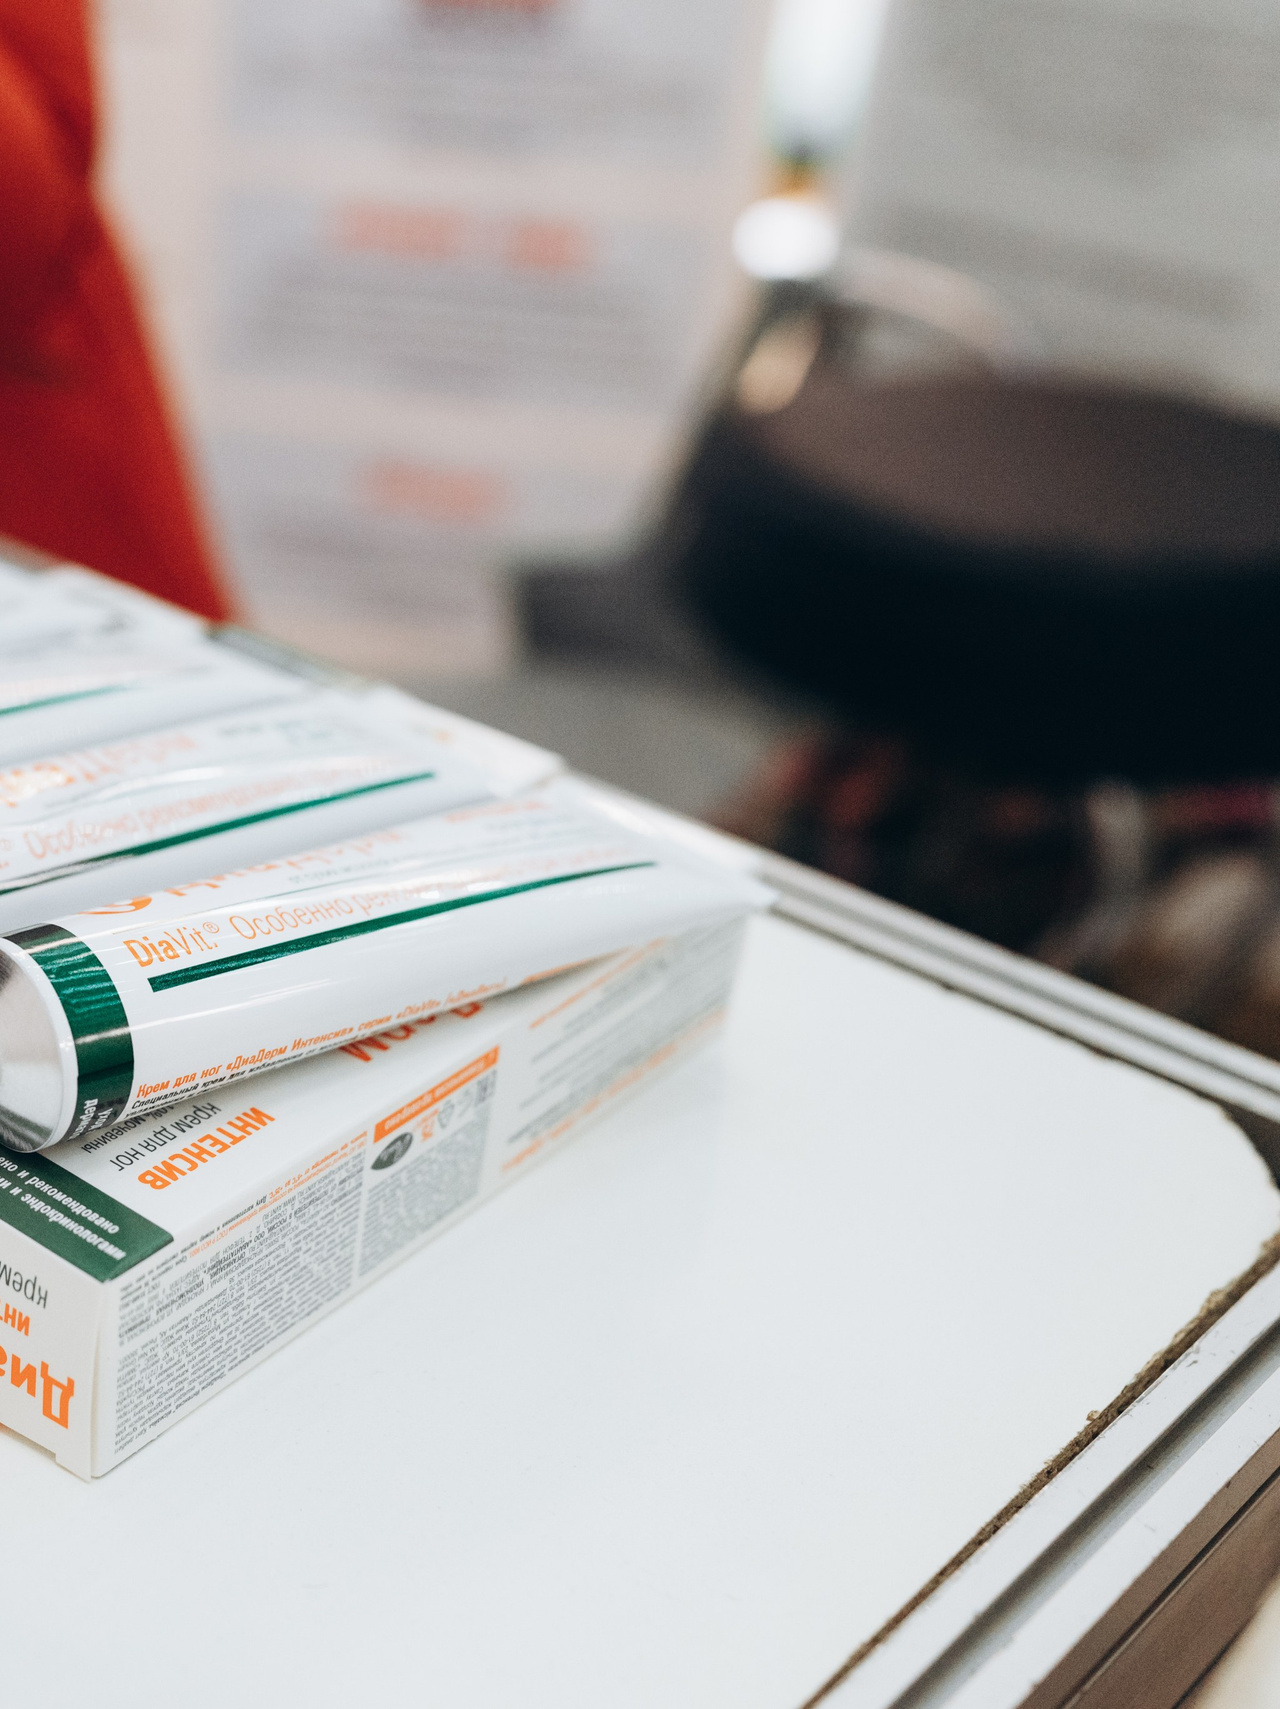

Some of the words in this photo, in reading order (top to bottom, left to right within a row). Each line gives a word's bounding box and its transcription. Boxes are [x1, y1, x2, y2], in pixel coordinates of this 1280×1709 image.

[228, 895, 355, 940] Особенно
[136, 1079, 170, 1099] Крем
[173, 1071, 198, 1089] для
[200, 1063, 223, 1082] ног
[226, 1045, 288, 1073] «ДиаДерм
[291, 1026, 355, 1053] Интенсив»
[131, 1081, 200, 1111] Специальный
[81, 1112, 149, 1154] мочевины
[137, 1124, 178, 1154] для
[169, 1102, 223, 1135] крем
[108, 1146, 147, 1173] ног
[136, 1106, 277, 1191] ИНТЕНСИВ
[9, 1183, 21, 1197] и
[20, 1191, 127, 1261] эндокринологами
[17, 1167, 30, 1180] и
[25, 1173, 120, 1235] рекомендовано
